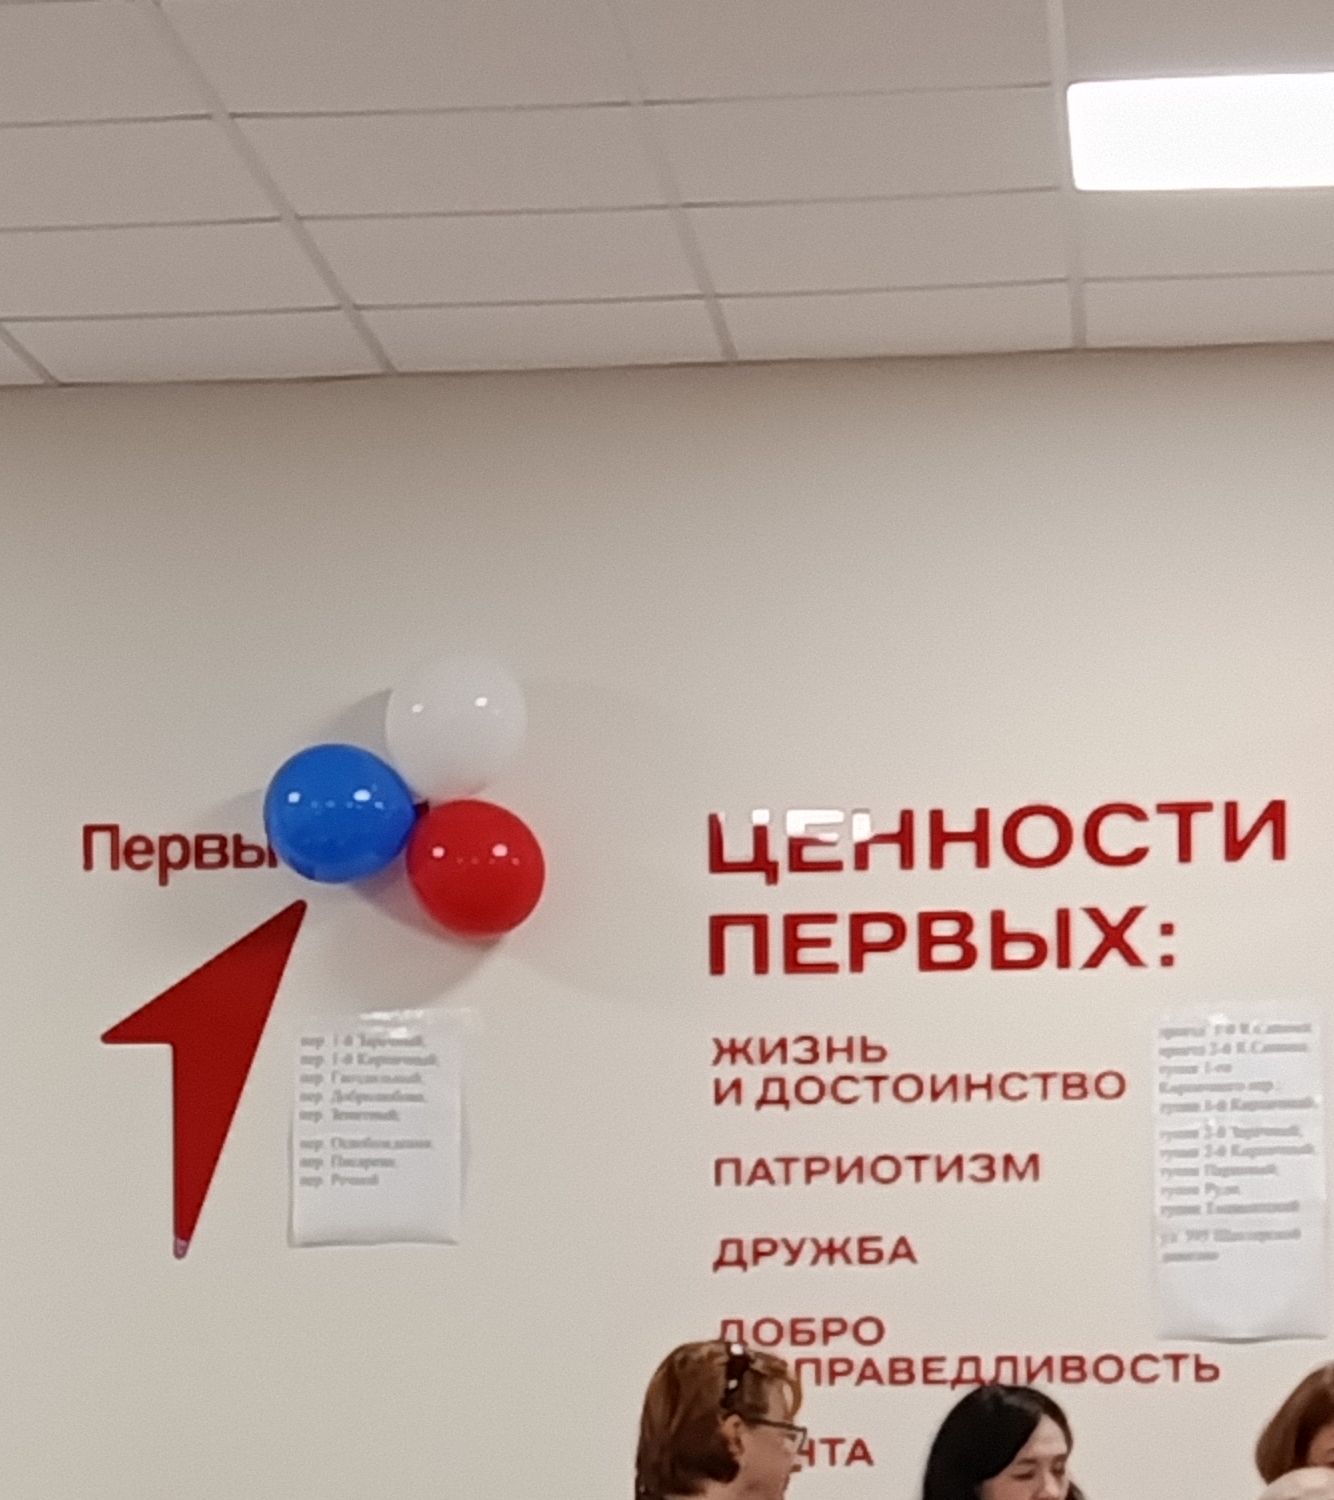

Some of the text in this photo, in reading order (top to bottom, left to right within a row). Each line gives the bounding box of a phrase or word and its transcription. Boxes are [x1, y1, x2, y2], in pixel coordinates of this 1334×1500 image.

[83, 824, 277, 886] Первы
[709, 798, 1288, 886] ЦЕННОСТИ
[709, 906, 1174, 976] ПЕРВЫХ:
[713, 1035, 887, 1066] ЖИЗНЬ
[714, 1078, 742, 1105] И
[755, 1071, 1126, 1111] ДОСТОИНСТВО
[714, 1153, 1039, 1186] ПАТРИОТИЗМ
[713, 1236, 917, 1272] ДРУЖБА
[794, 1353, 1220, 1390] ПРАВЕДЛИВОСТЬ
